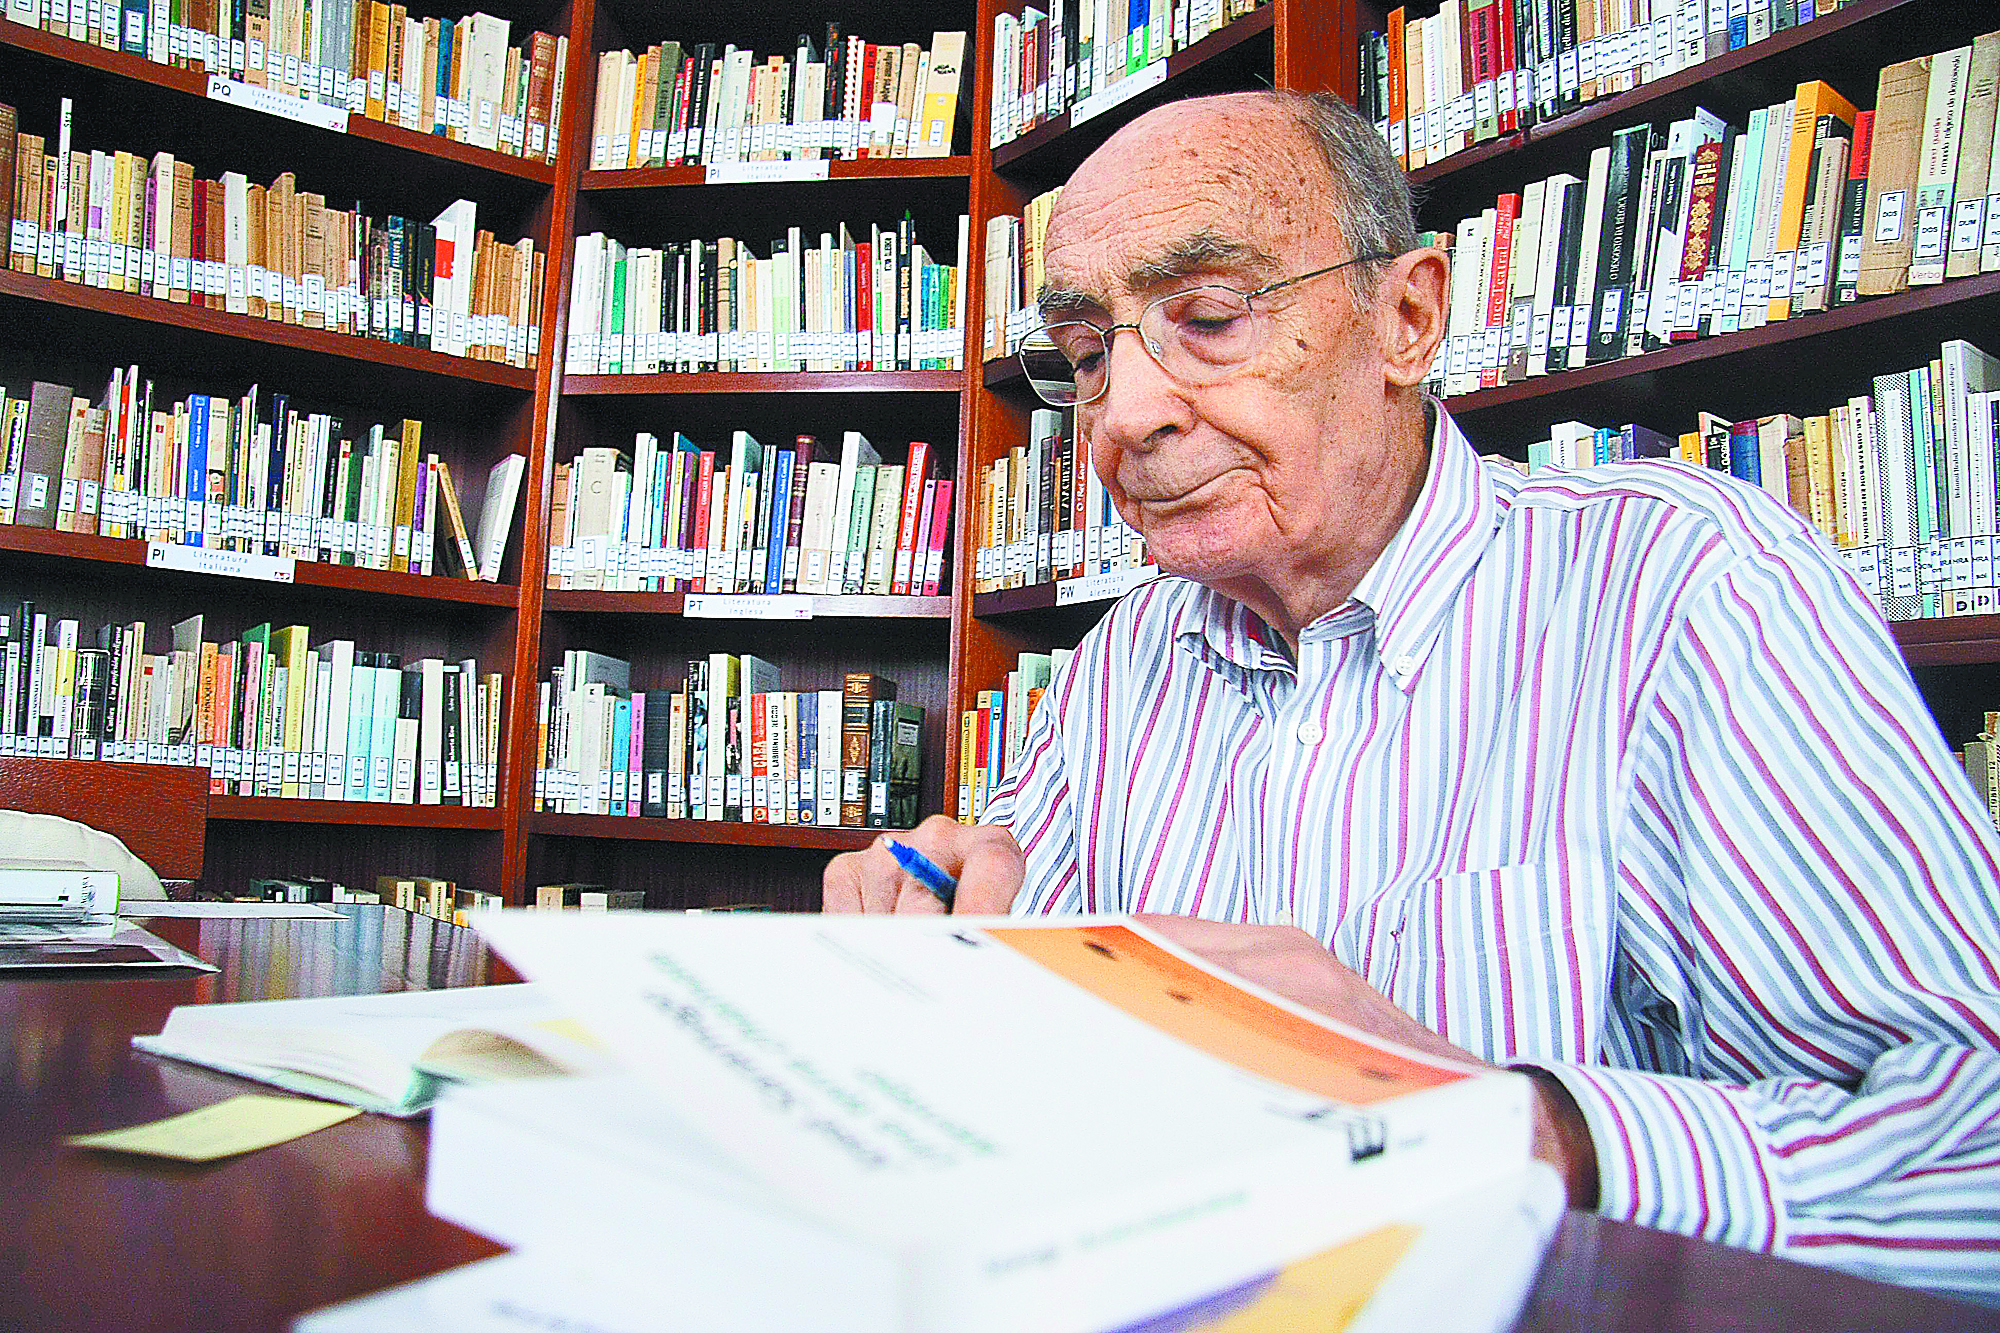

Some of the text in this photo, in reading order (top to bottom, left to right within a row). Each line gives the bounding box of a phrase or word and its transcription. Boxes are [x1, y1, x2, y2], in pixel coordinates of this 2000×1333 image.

[213, 82, 231, 97] PQ
[252, 89, 304, 109] Literatura
[255, 100, 299, 117] Francesa
[710, 168, 720, 179] PI
[1610, 236, 1624, 271] DESGOSTO
[1492, 246, 1509, 296] Teatral
[1911, 271, 1941, 279] Verbo
[1856, 432, 1865, 487] GUSTAFSSON
[1061, 449, 1072, 508] MACBETH
[1860, 500, 1869, 540] PERSONA
[152, 549, 165, 561] PI
[193, 551, 248, 564] Literatura
[199, 562, 241, 573] Italiana
[1086, 575, 1124, 587] Literatura
[1060, 585, 1075, 599] PW
[1089, 588, 1121, 597] Alemana
[688, 600, 703, 611] PT
[753, 740, 767, 768] CLEA
[771, 732, 779, 768] LABIRINTO
